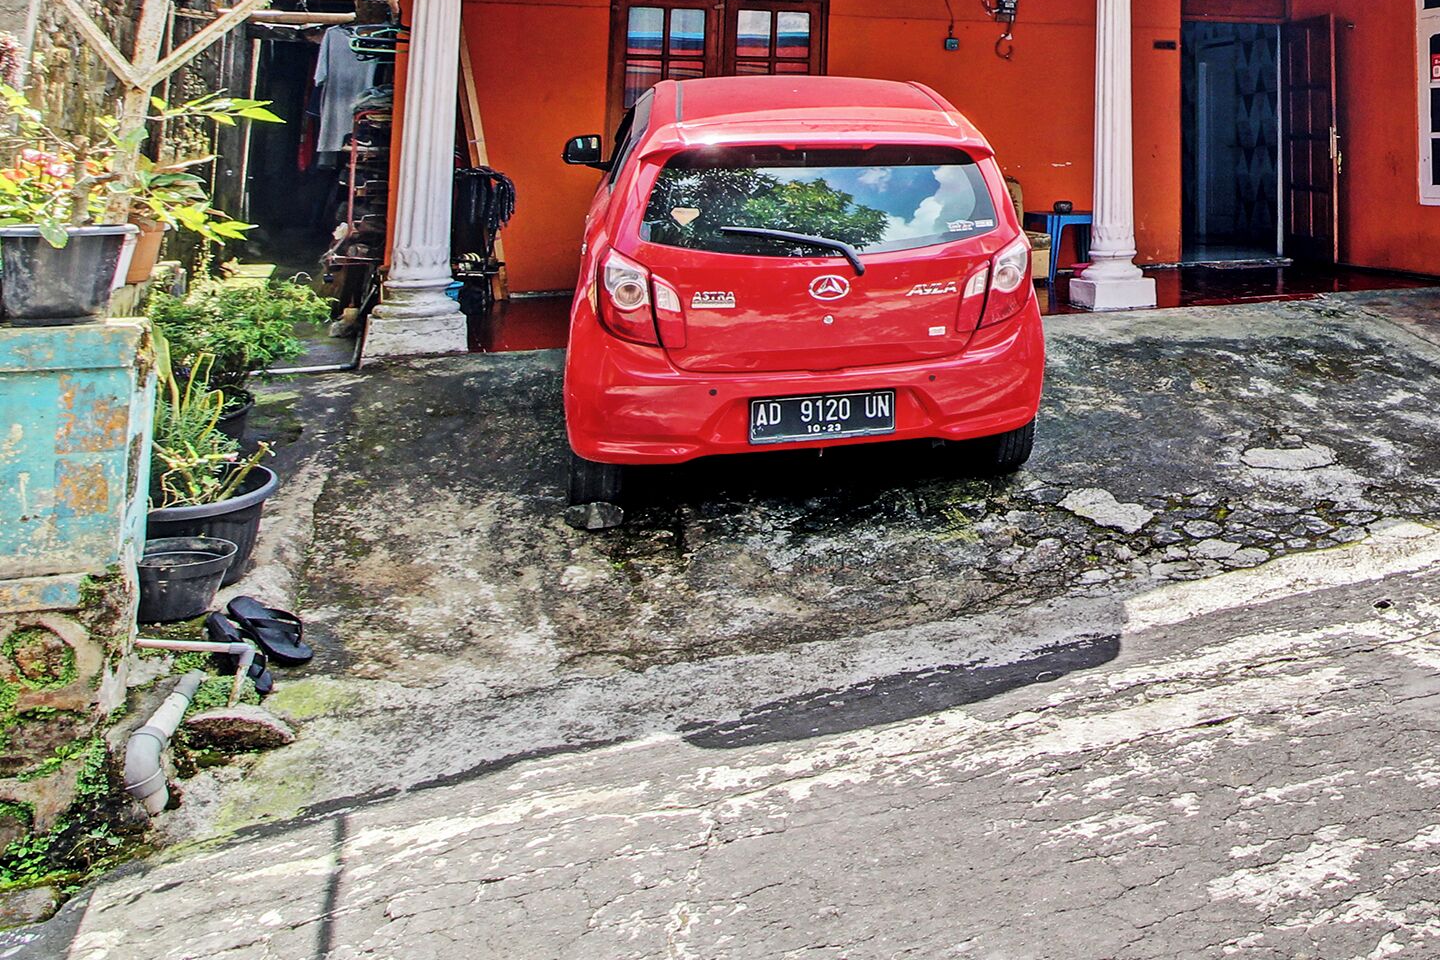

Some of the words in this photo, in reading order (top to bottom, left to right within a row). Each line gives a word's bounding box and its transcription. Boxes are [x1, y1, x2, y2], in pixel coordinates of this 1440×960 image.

[692, 291, 736, 303] ASTRA
[756, 403, 781, 426] AD
[800, 398, 850, 422] 9120
[865, 395, 890, 418] UN
